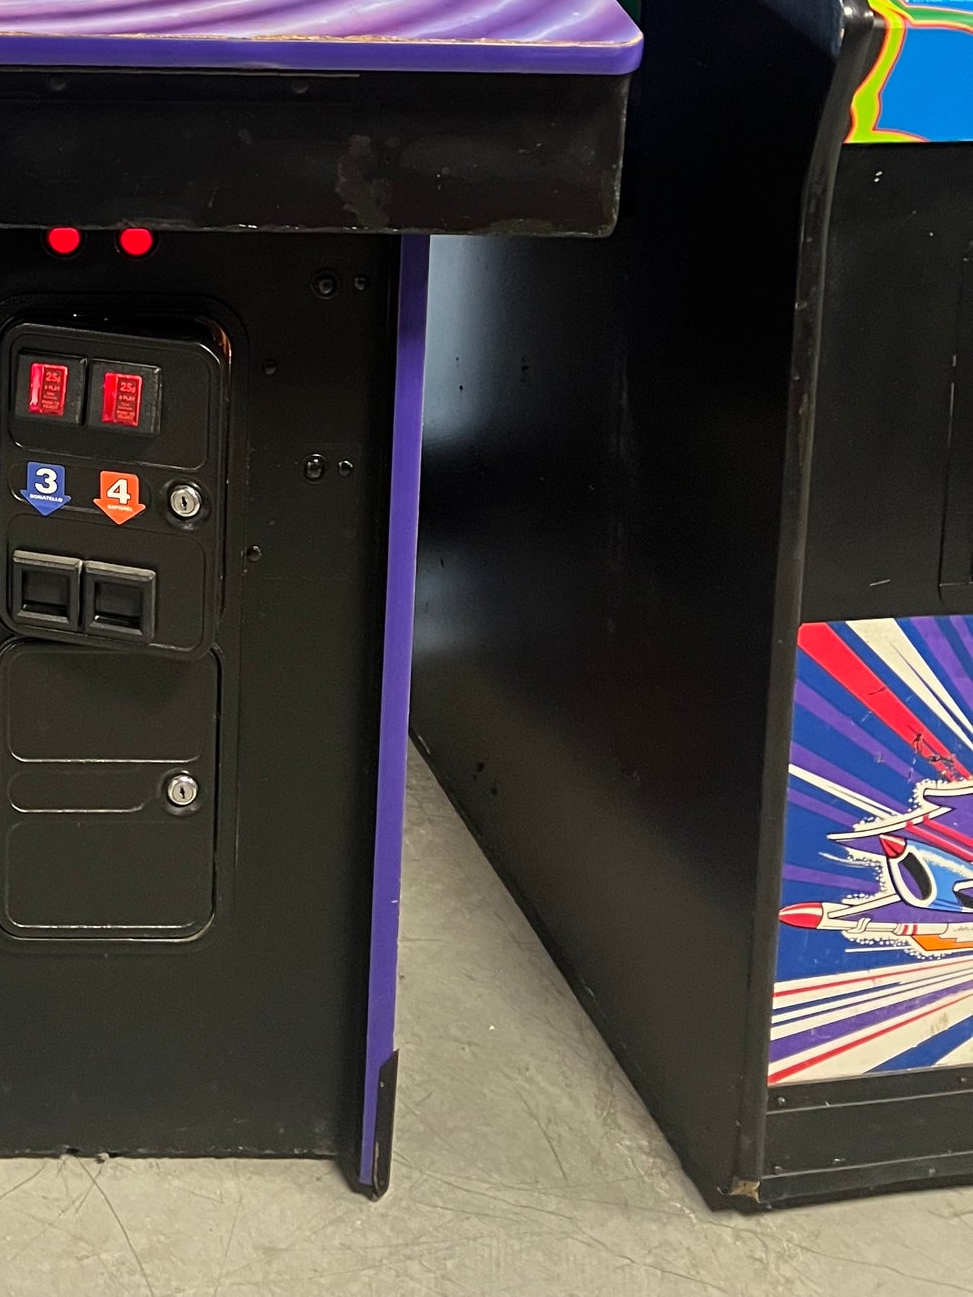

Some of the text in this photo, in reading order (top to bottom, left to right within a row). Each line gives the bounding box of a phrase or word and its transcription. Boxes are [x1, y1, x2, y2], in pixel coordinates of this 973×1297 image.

[34, 467, 58, 494] 3
[106, 478, 131, 505] 4
[29, 493, 63, 503] DONATELLO
